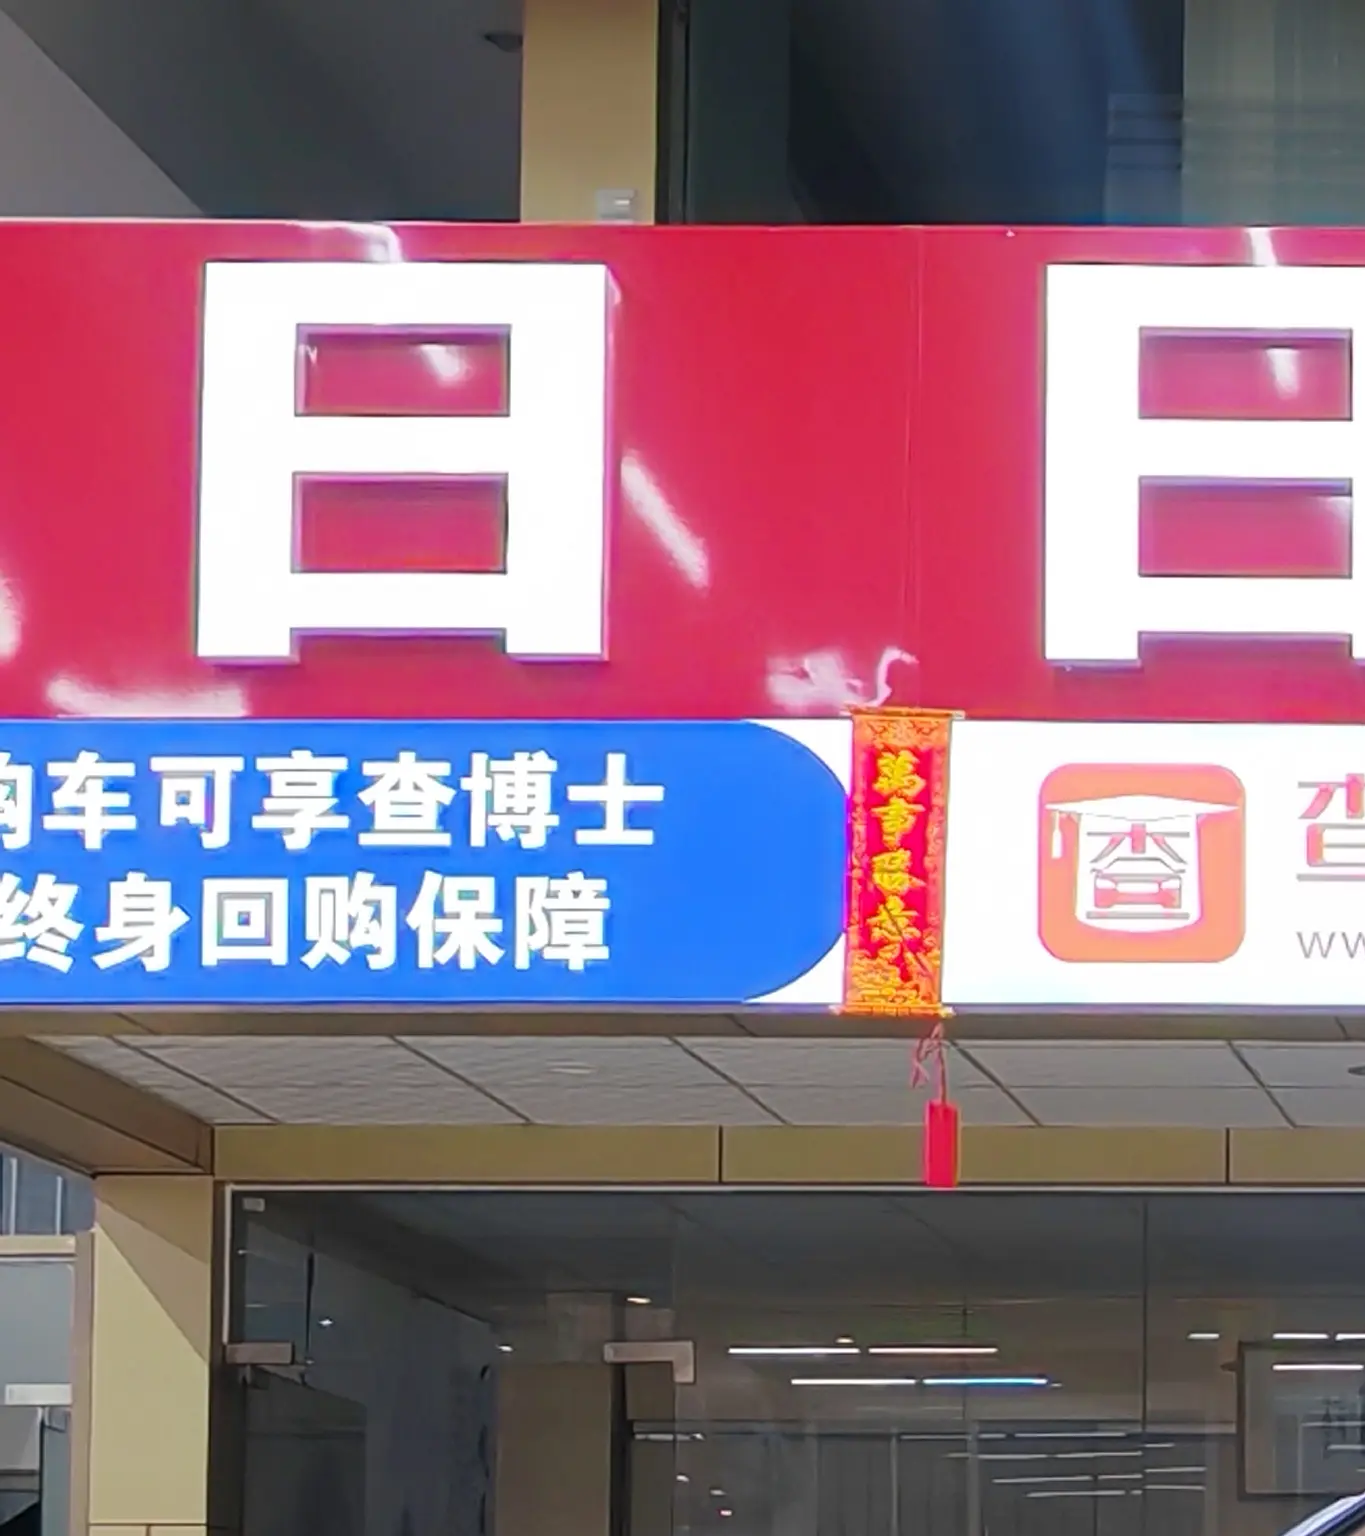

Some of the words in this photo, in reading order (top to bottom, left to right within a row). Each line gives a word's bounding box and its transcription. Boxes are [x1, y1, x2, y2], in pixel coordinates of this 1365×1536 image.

[0, 872, 611, 973] 终身回购保障
